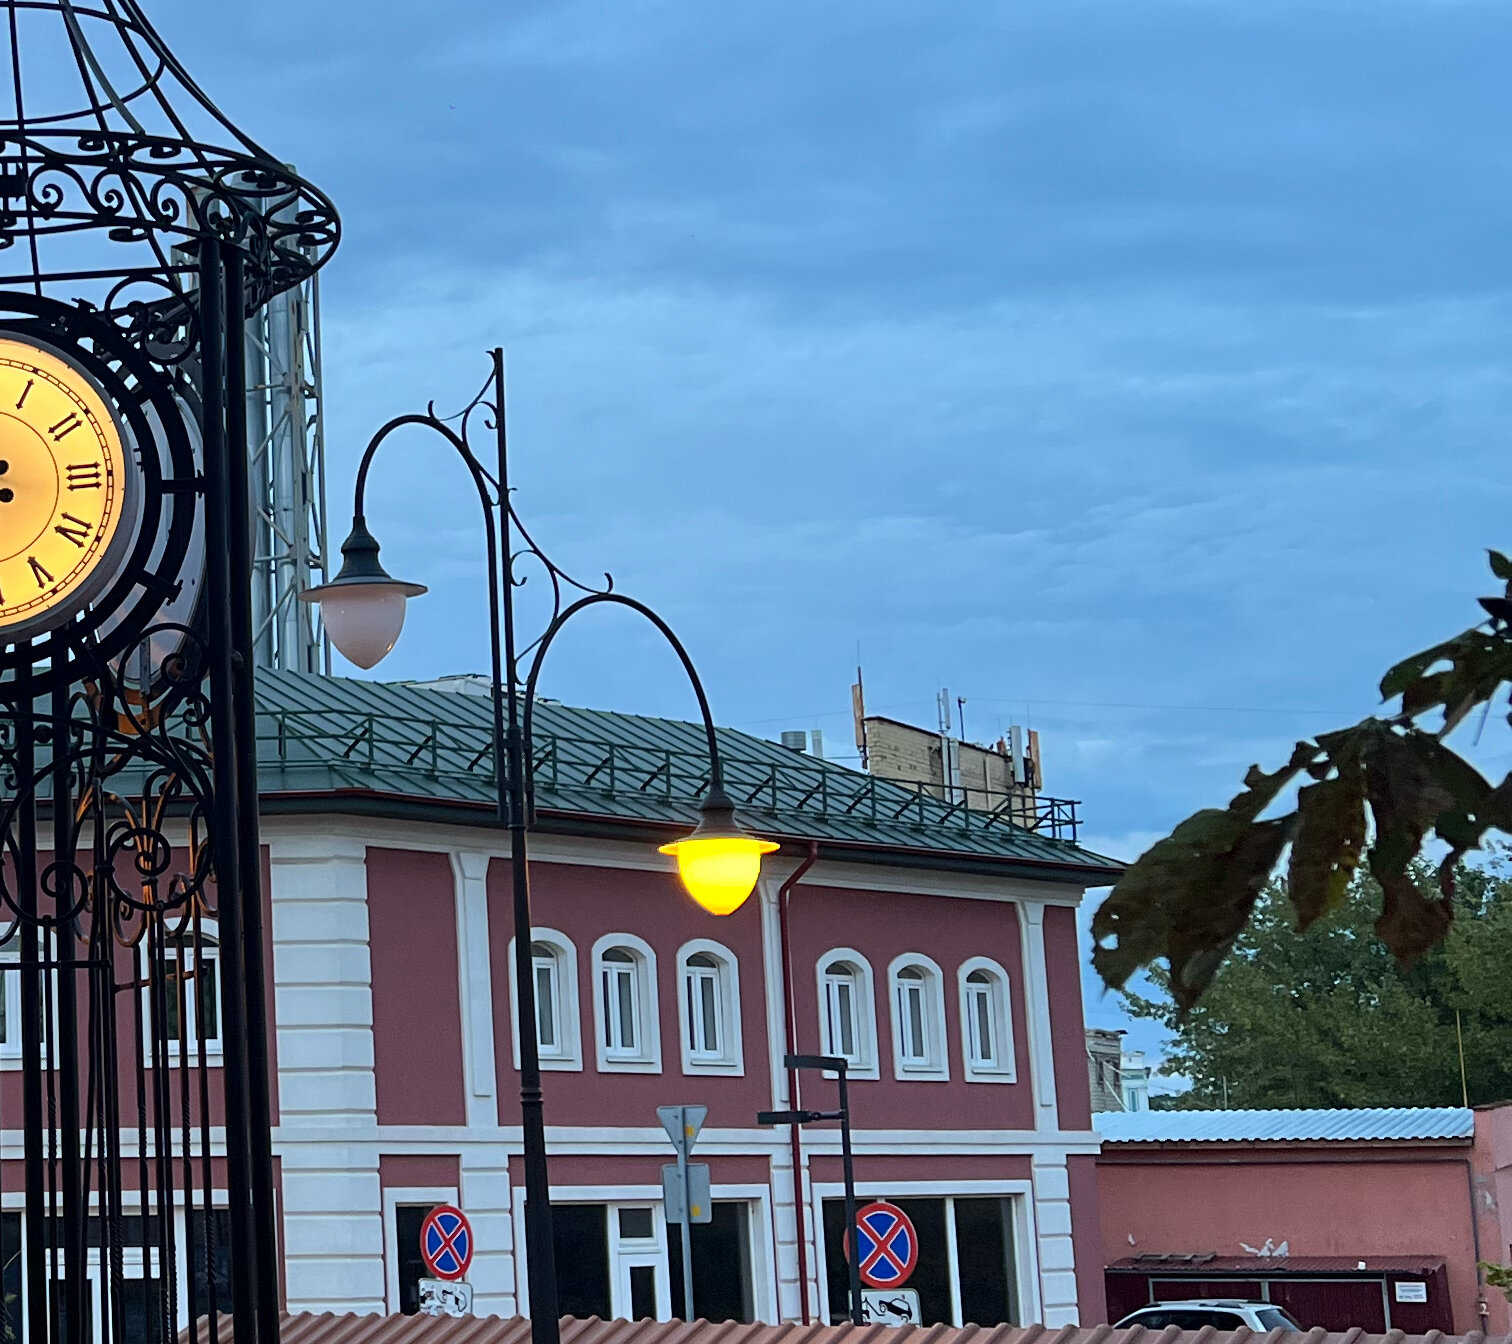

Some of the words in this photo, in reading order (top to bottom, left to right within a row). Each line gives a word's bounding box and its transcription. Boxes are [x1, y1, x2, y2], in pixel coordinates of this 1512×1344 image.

[16, 379, 34, 410] I
[48, 412, 83, 442] II
[66, 461, 102, 491] III
[54, 512, 93, 548] IV
[27, 556, 55, 589] V
